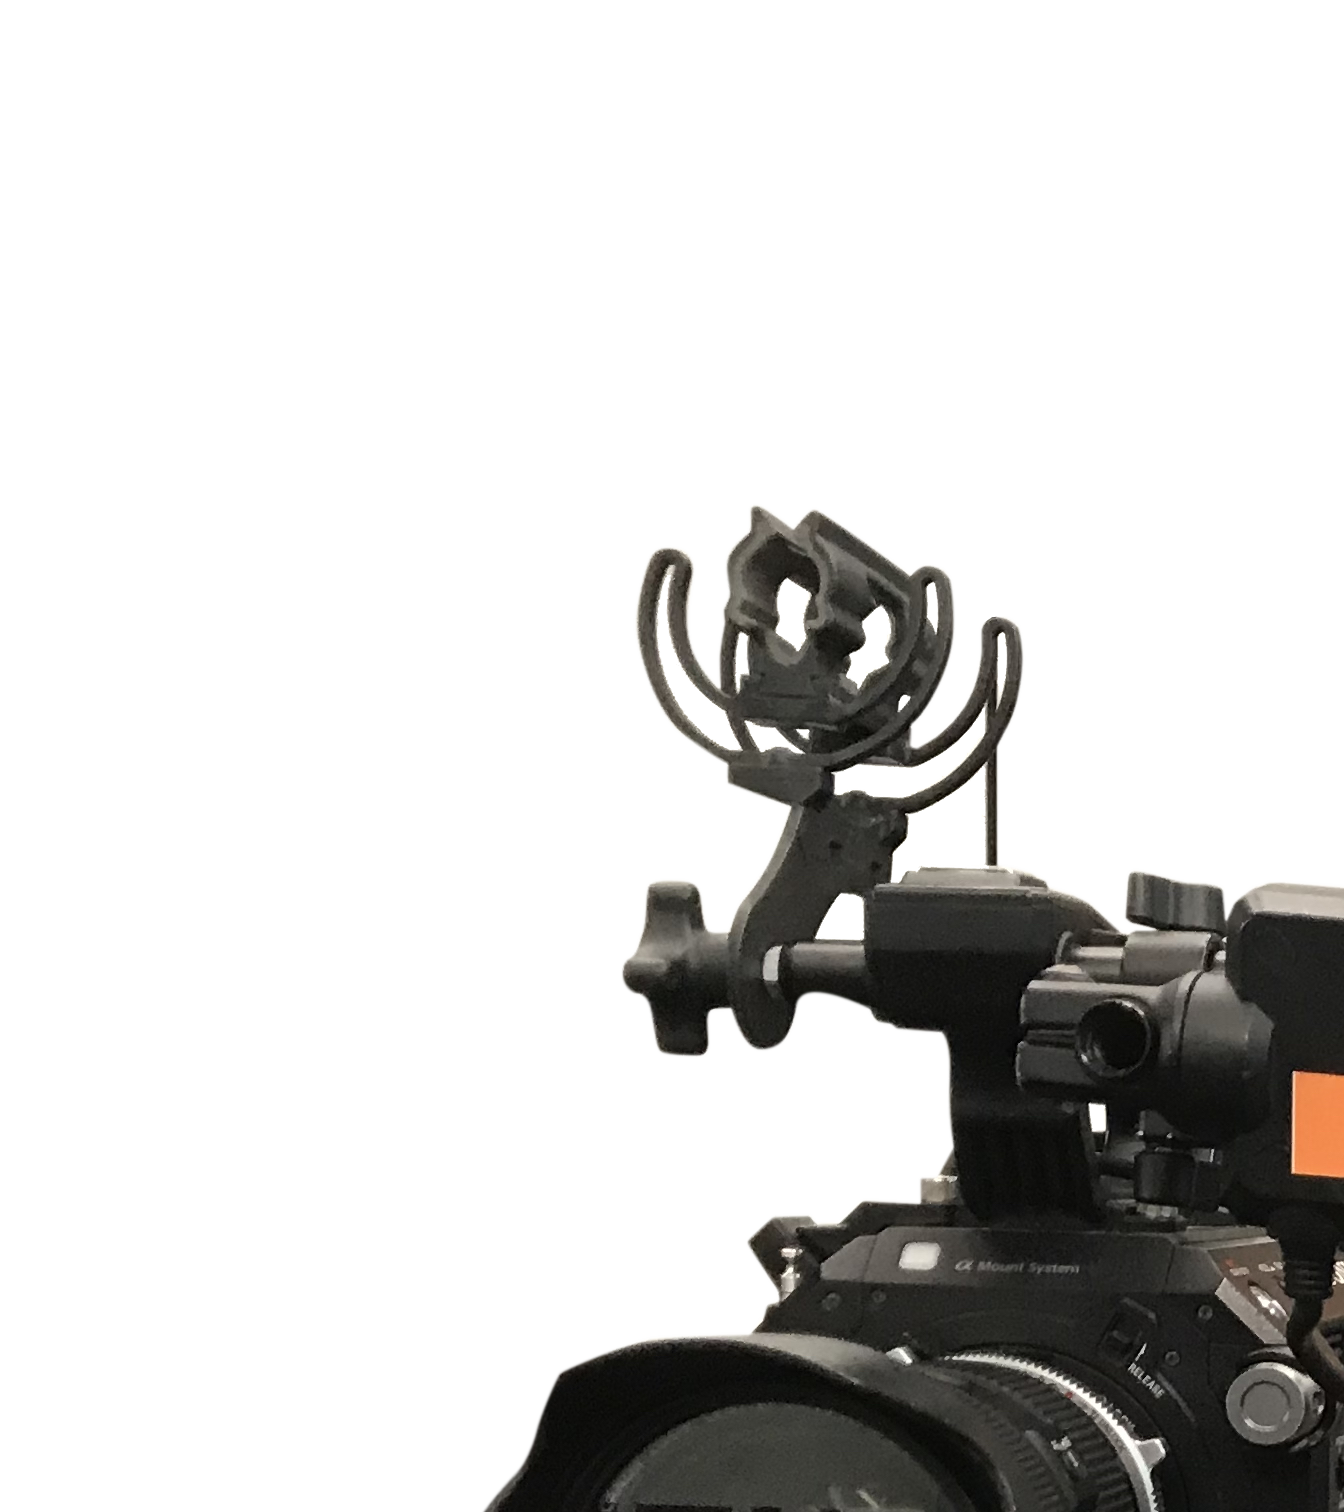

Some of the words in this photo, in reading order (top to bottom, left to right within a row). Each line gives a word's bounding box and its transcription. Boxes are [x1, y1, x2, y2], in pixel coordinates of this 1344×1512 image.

[977, 1261, 1025, 1273] Mount
[1027, 1262, 1080, 1275] System
[1127, 1362, 1166, 1399] RELEASE
